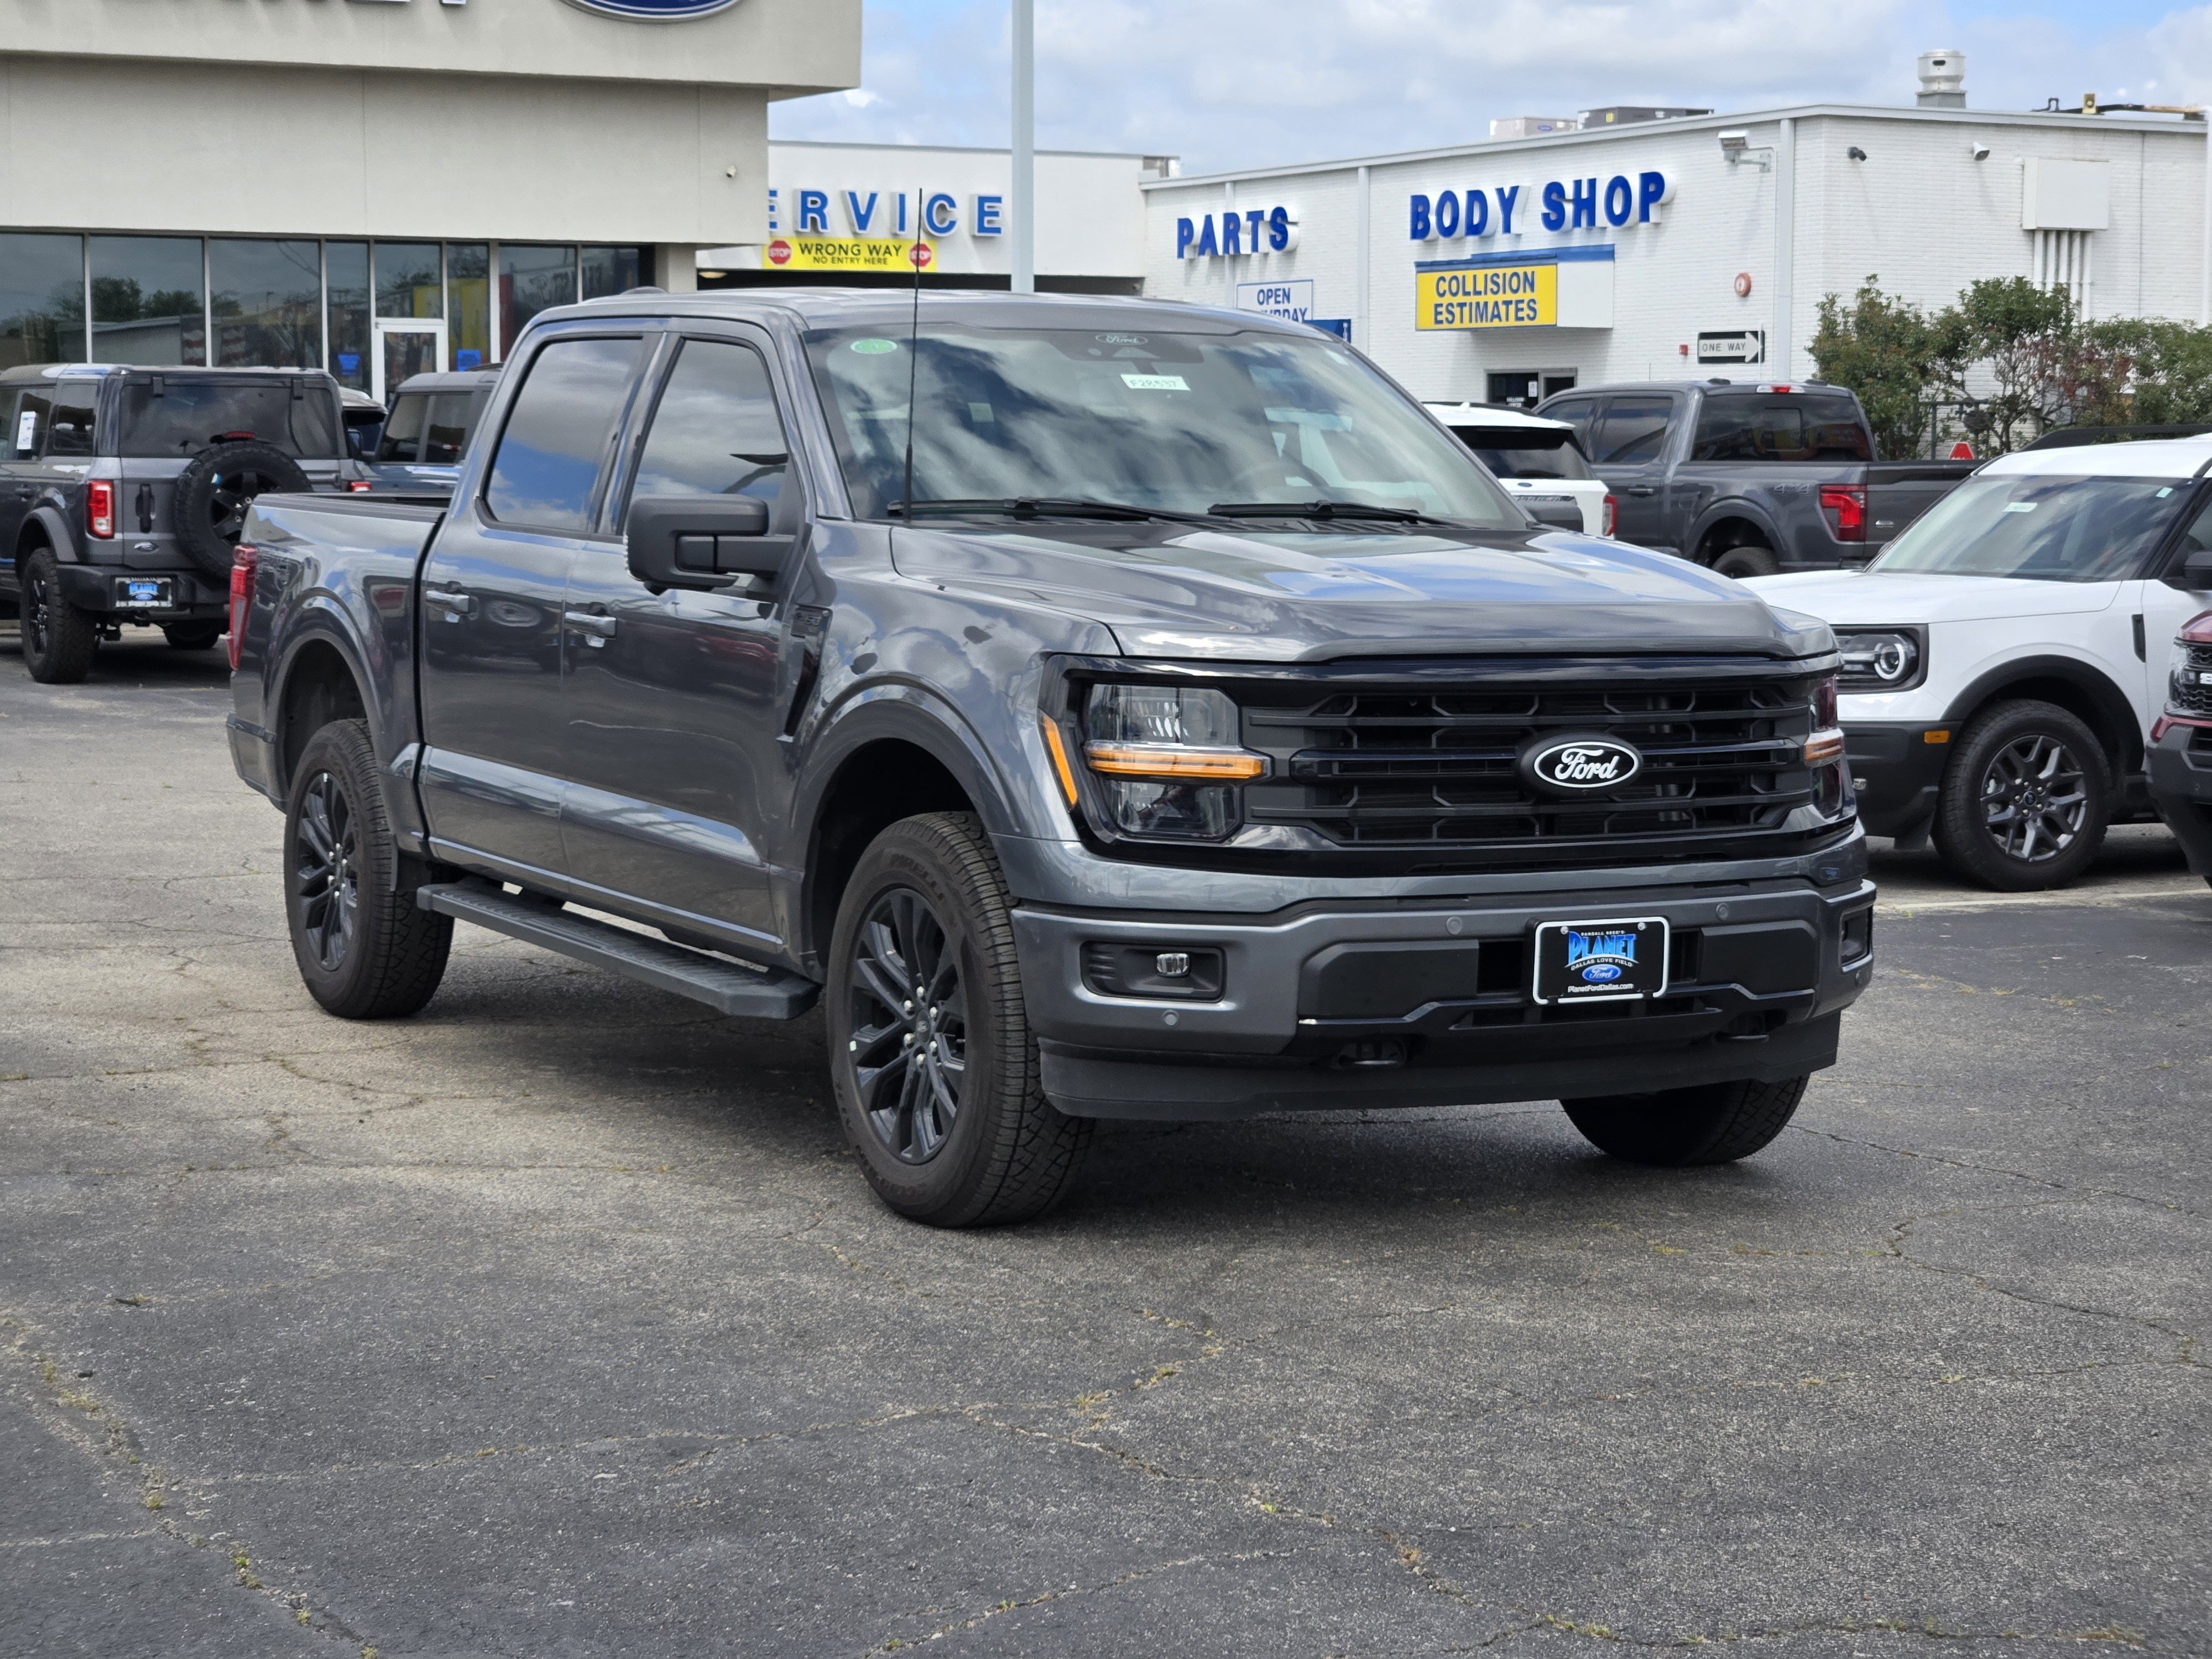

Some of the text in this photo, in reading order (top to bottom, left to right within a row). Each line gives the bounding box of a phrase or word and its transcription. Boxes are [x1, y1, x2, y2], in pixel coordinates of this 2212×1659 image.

[1410, 170, 1665, 241] BODY SHOP
[1177, 206, 1290, 259] PARTS
[799, 243, 902, 257] WRONG WAY
[1436, 270, 1535, 298] COLLISION
[1256, 287, 1291, 305] OPEN
[1434, 298, 1537, 325] ESTIMATES
[1702, 342, 1746, 352] ONE WAY
[1554, 748, 1620, 780] Ford
[1568, 931, 1637, 965] PLANET
[1571, 958, 1595, 971] DALLAS
[1615, 958, 1633, 967] FIELD
[1589, 966, 1614, 979] Ford
[1567, 983, 1634, 993] PlanetFordDallas.com
